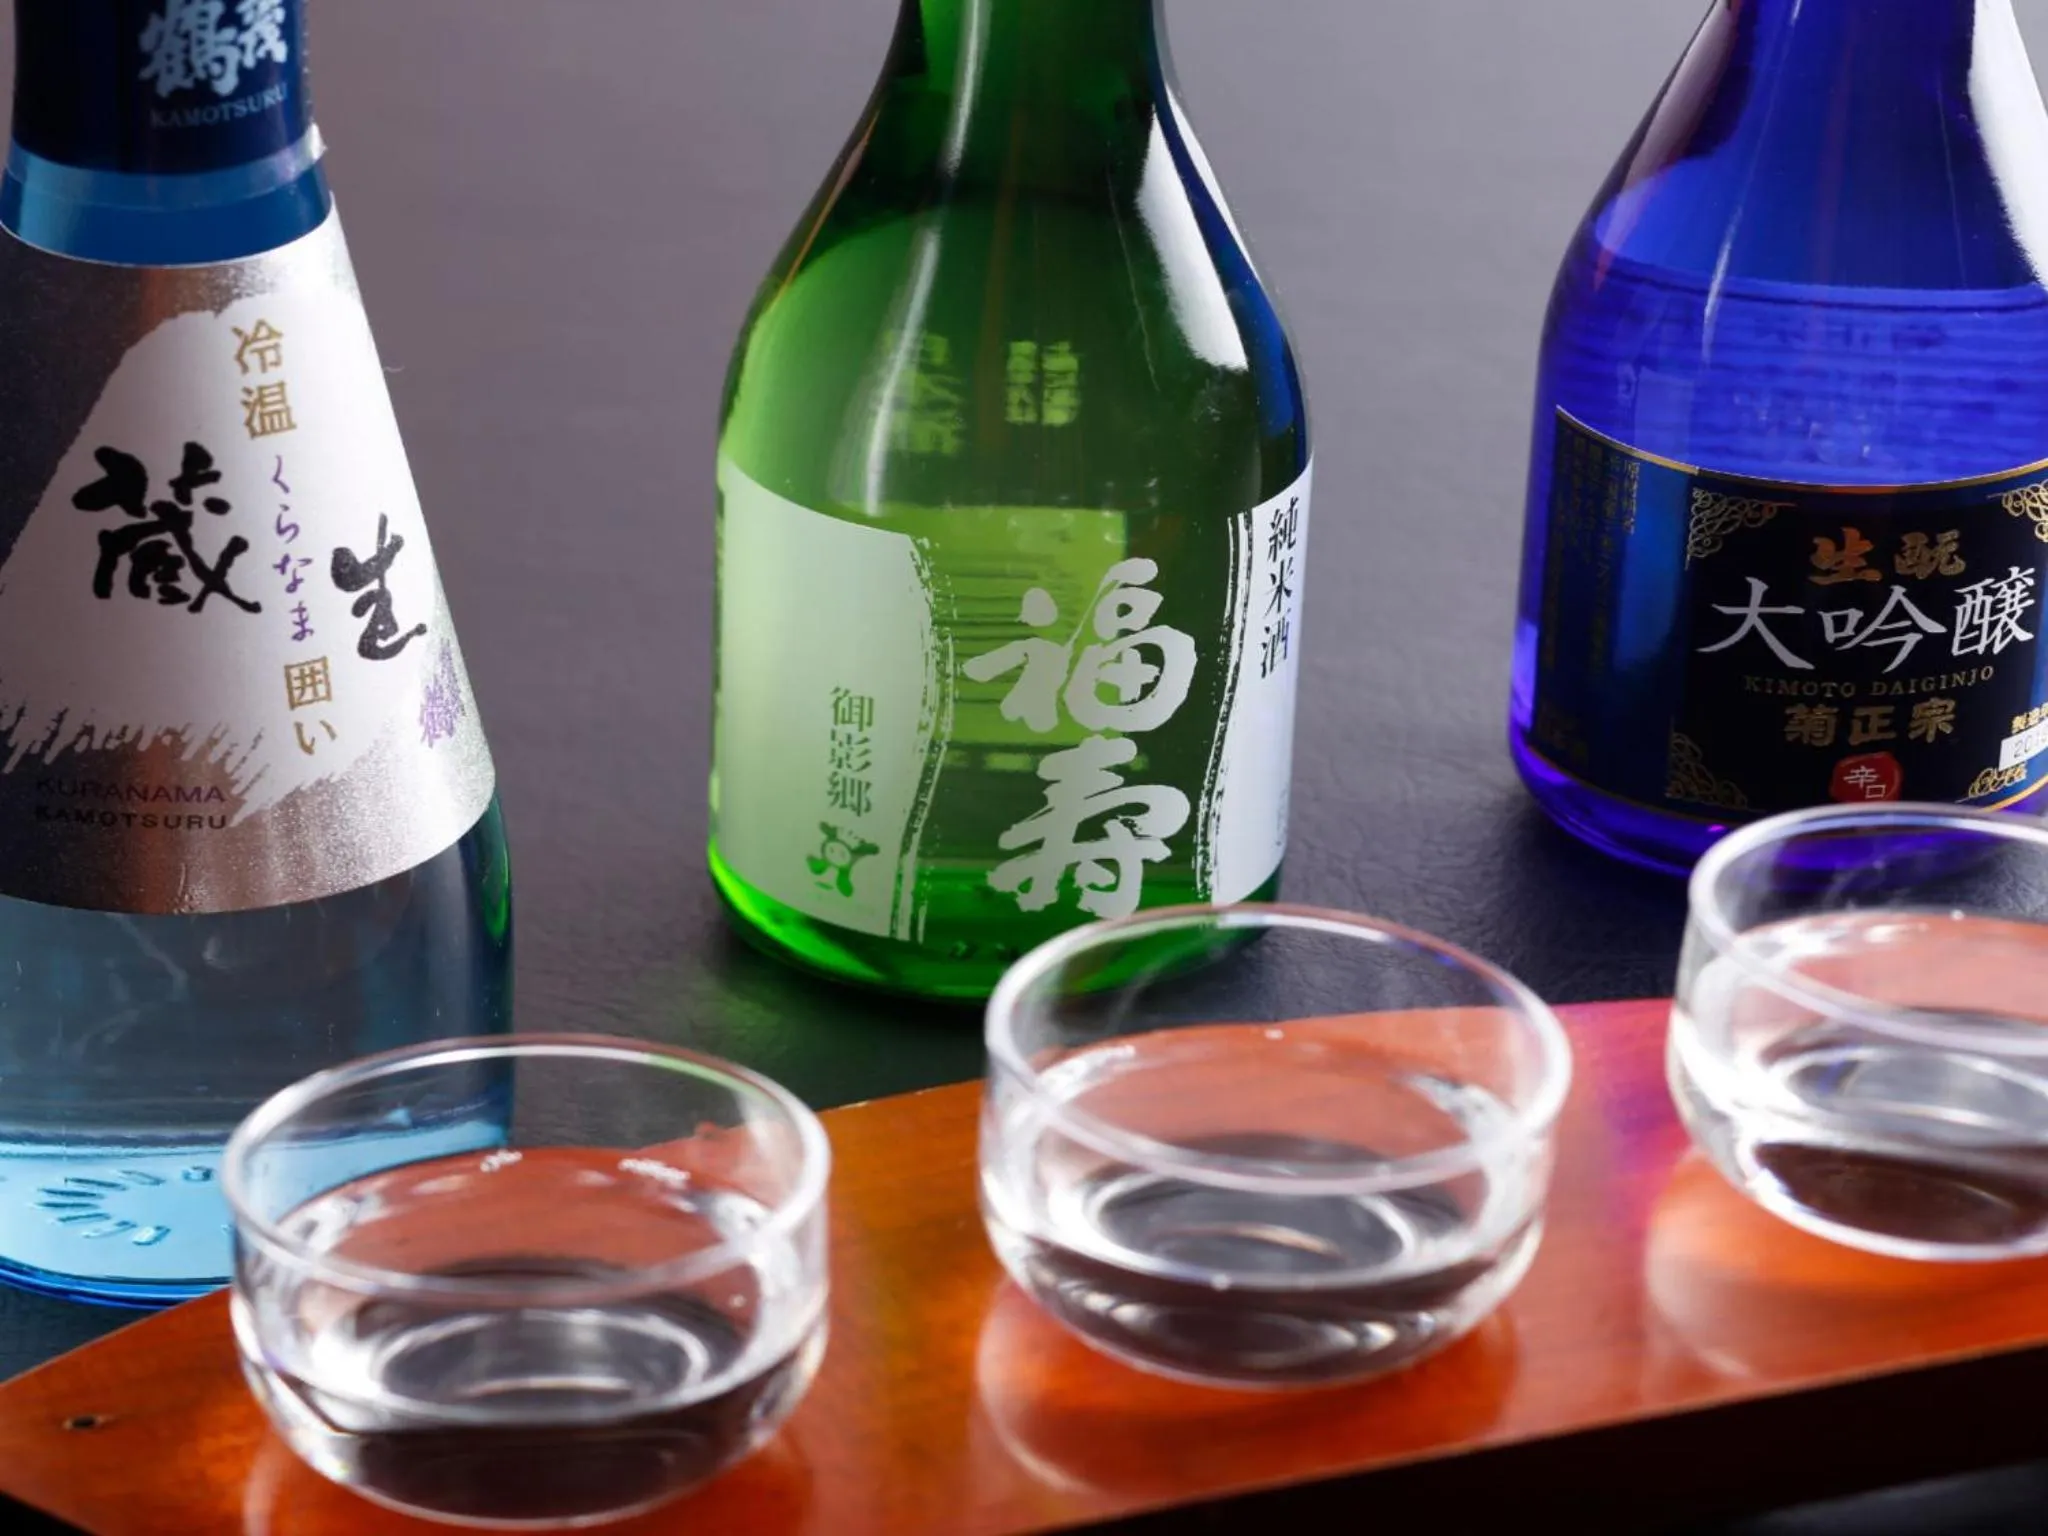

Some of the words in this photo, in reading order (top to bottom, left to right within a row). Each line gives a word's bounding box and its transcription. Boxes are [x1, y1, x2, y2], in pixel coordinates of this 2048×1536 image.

[231, 319, 297, 439] 冷温
[271, 455, 314, 642] くらなま
[1261, 496, 1300, 680] 純米酒
[1696, 566, 2036, 674] 大吟醸
[284, 656, 338, 756] 囲い
[1743, 675, 1857, 698] KIMOTO
[1870, 665, 1995, 697] DAIGINJO
[1783, 697, 1956, 748] 菊正宗
[36, 777, 226, 803] KURANAMA
[827, 686, 875, 818] 御影郷
[963, 557, 1198, 920] 福寿
[1843, 765, 1887, 799] 辛口
[34, 805, 227, 829] KAMOTSURU
